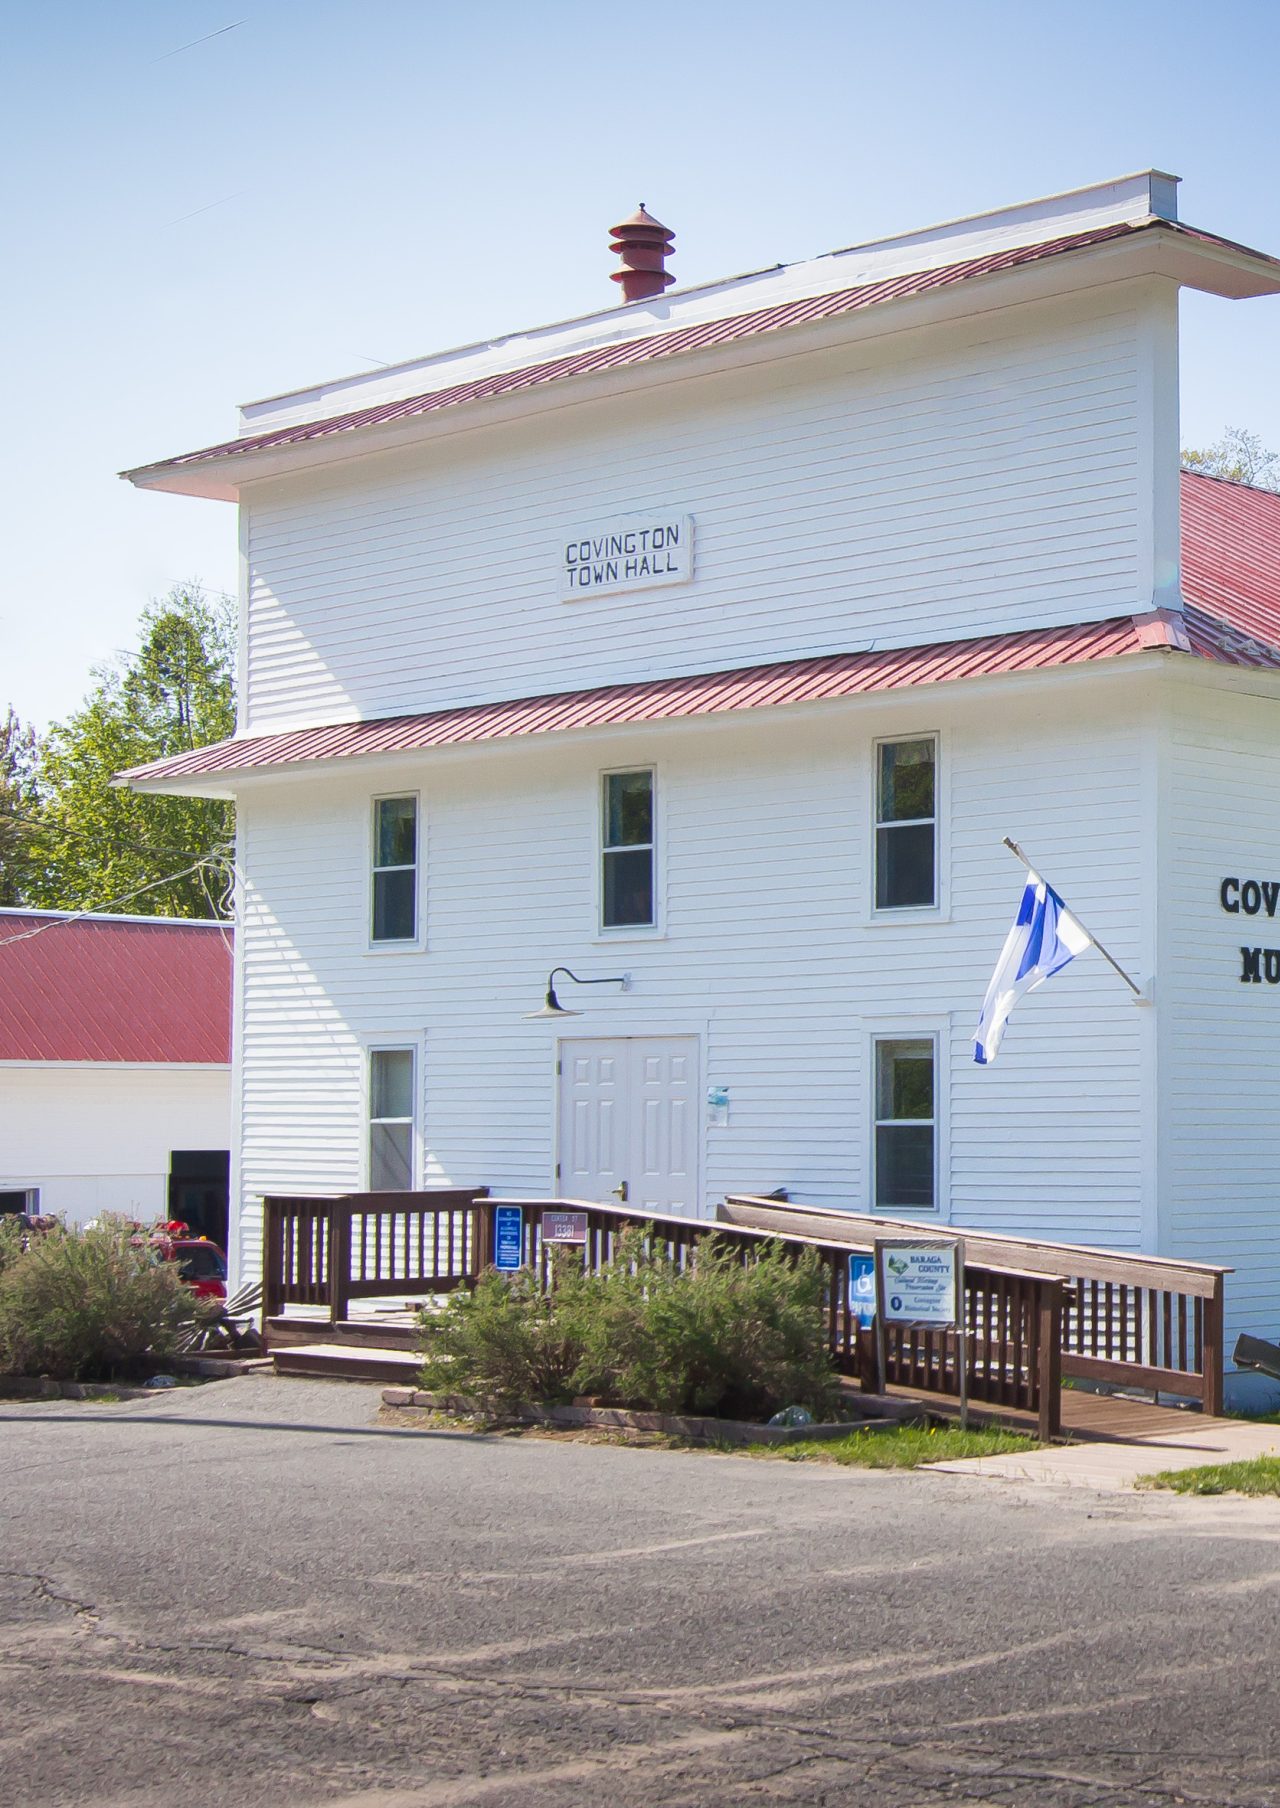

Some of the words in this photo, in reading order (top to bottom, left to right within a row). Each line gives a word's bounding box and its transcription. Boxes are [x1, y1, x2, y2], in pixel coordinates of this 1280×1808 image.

[566, 524, 680, 564] COVINGTON
[567, 561, 618, 587] TOWN
[625, 552, 679, 578] HALL
[910, 1255, 942, 1264] BARAGA
[918, 1264, 950, 1273] COUNTY
